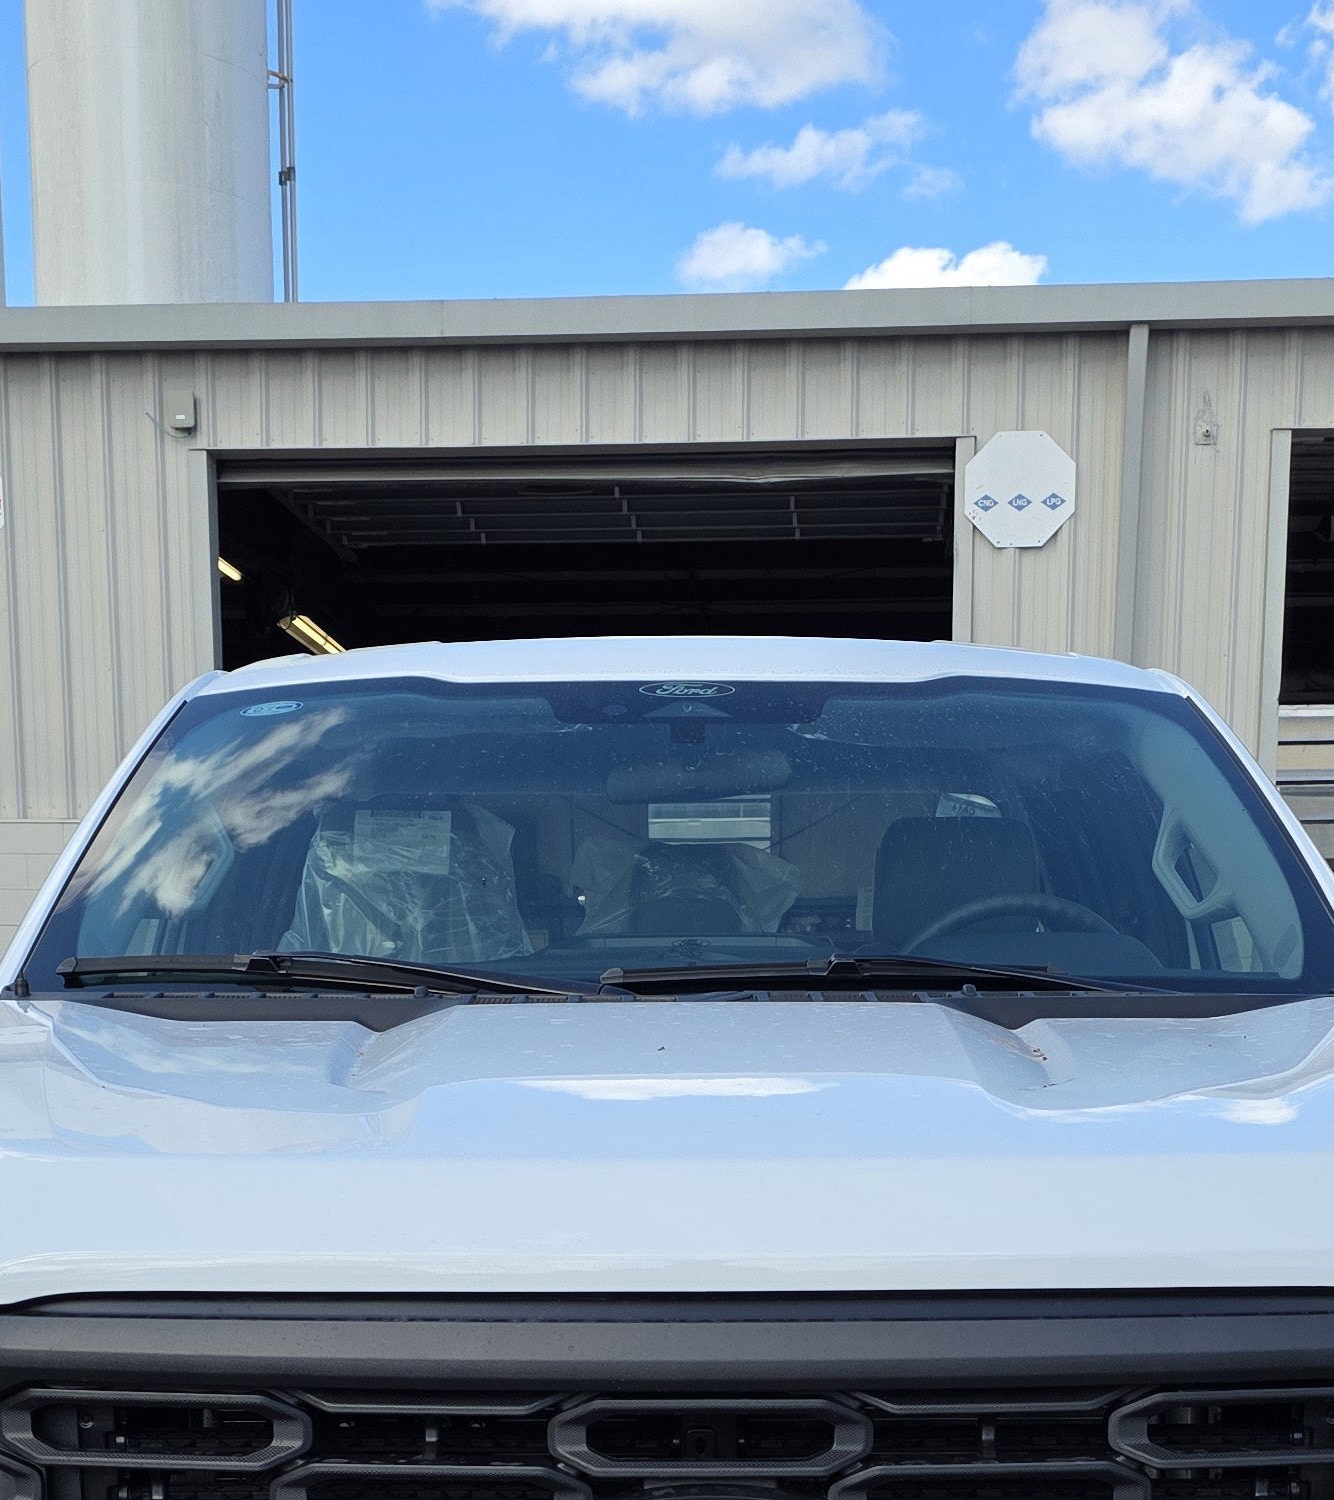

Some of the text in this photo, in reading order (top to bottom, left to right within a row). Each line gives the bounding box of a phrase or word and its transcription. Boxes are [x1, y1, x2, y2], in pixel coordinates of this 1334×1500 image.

[977, 497, 1062, 507] CNG LNG LPG
[655, 682, 719, 695] Ford
